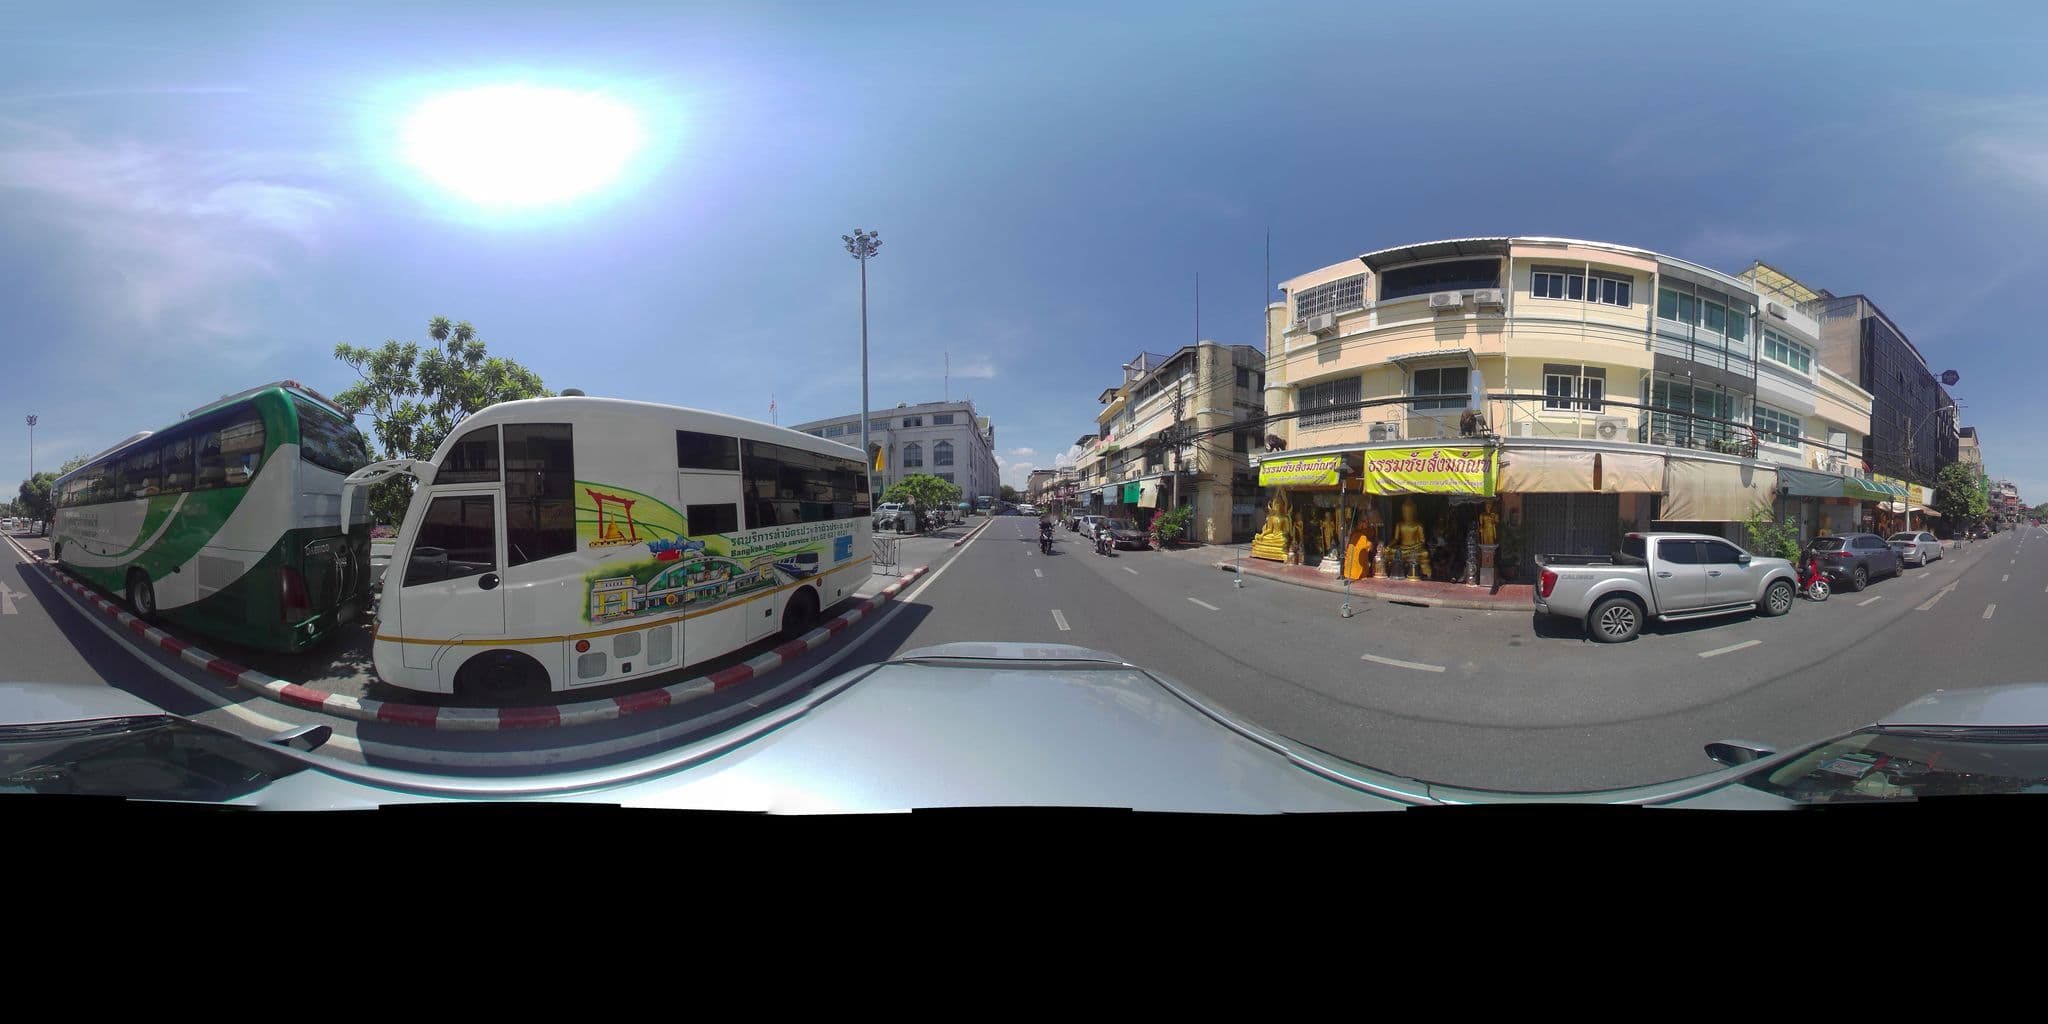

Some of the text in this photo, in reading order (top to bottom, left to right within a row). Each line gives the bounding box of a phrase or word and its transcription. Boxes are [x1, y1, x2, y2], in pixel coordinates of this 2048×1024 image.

[731, 545, 763, 557] Bangkok
[766, 541, 787, 550] mobile
[789, 538, 809, 546] service
